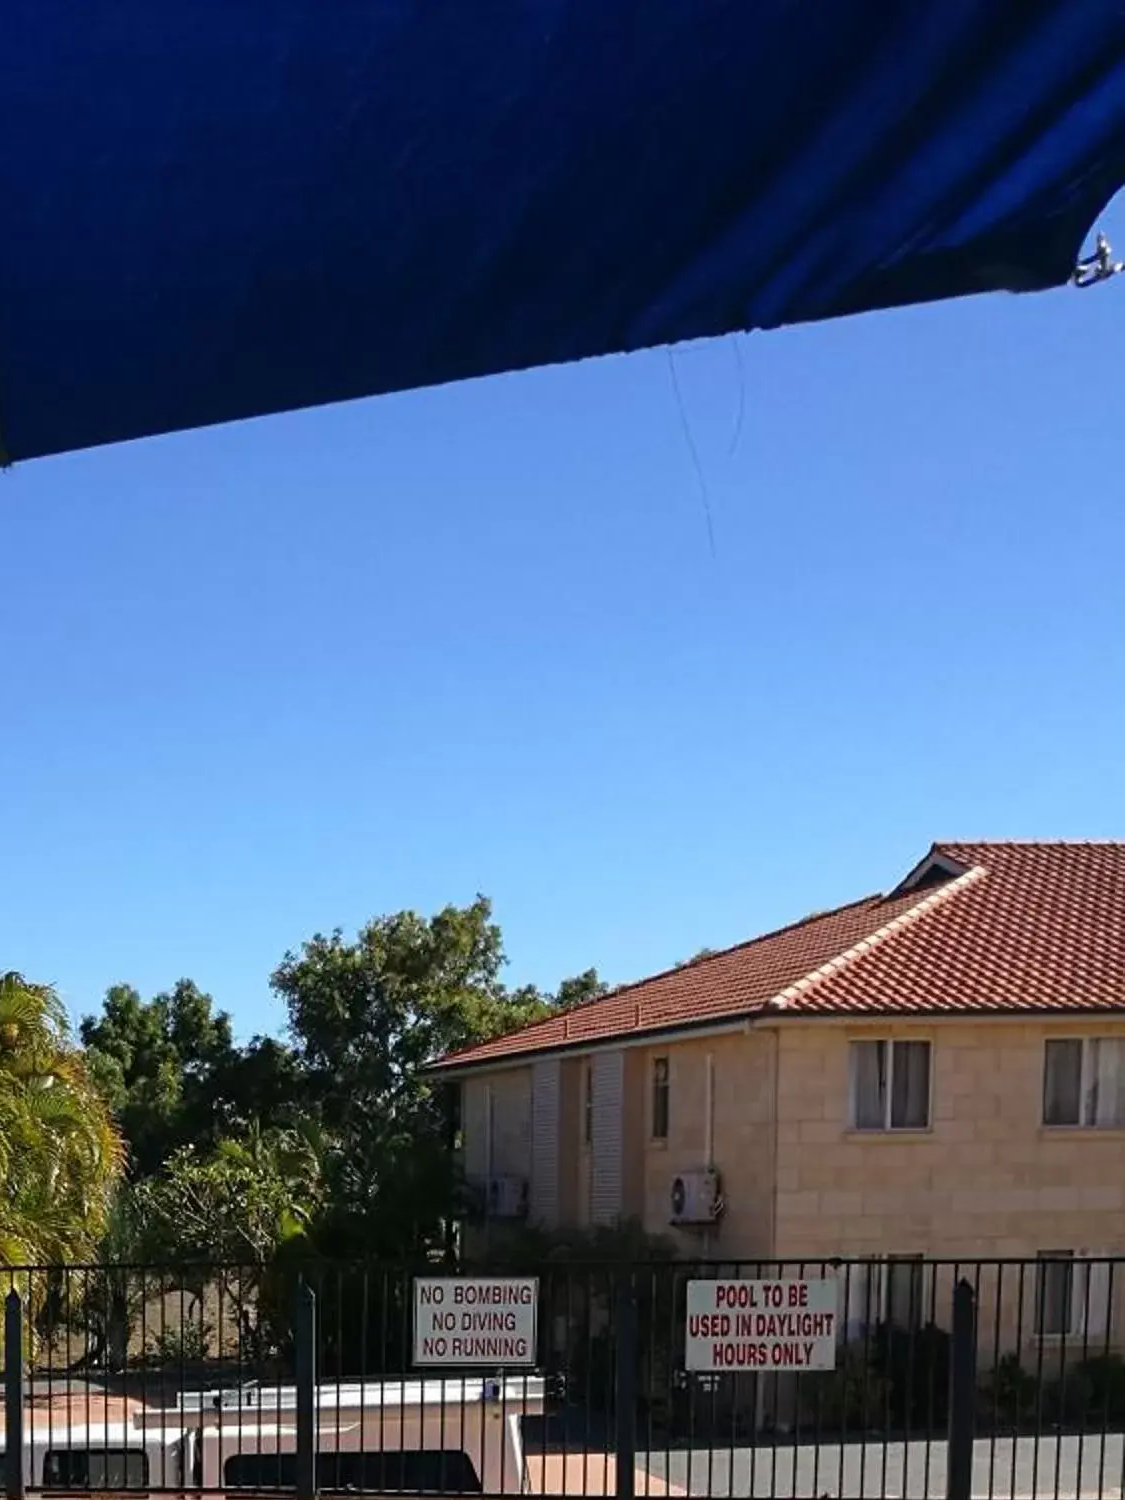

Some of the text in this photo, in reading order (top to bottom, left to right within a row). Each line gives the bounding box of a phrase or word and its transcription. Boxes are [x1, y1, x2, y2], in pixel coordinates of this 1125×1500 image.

[420, 1285, 532, 1305] NO BOMBING
[716, 1284, 808, 1308] POOL TO BE
[432, 1312, 516, 1331] NO DIVING
[689, 1313, 834, 1337] USED IN DAYLIGHT
[423, 1337, 527, 1357] NO RUNNING
[712, 1342, 814, 1366] HOURS ONLY
